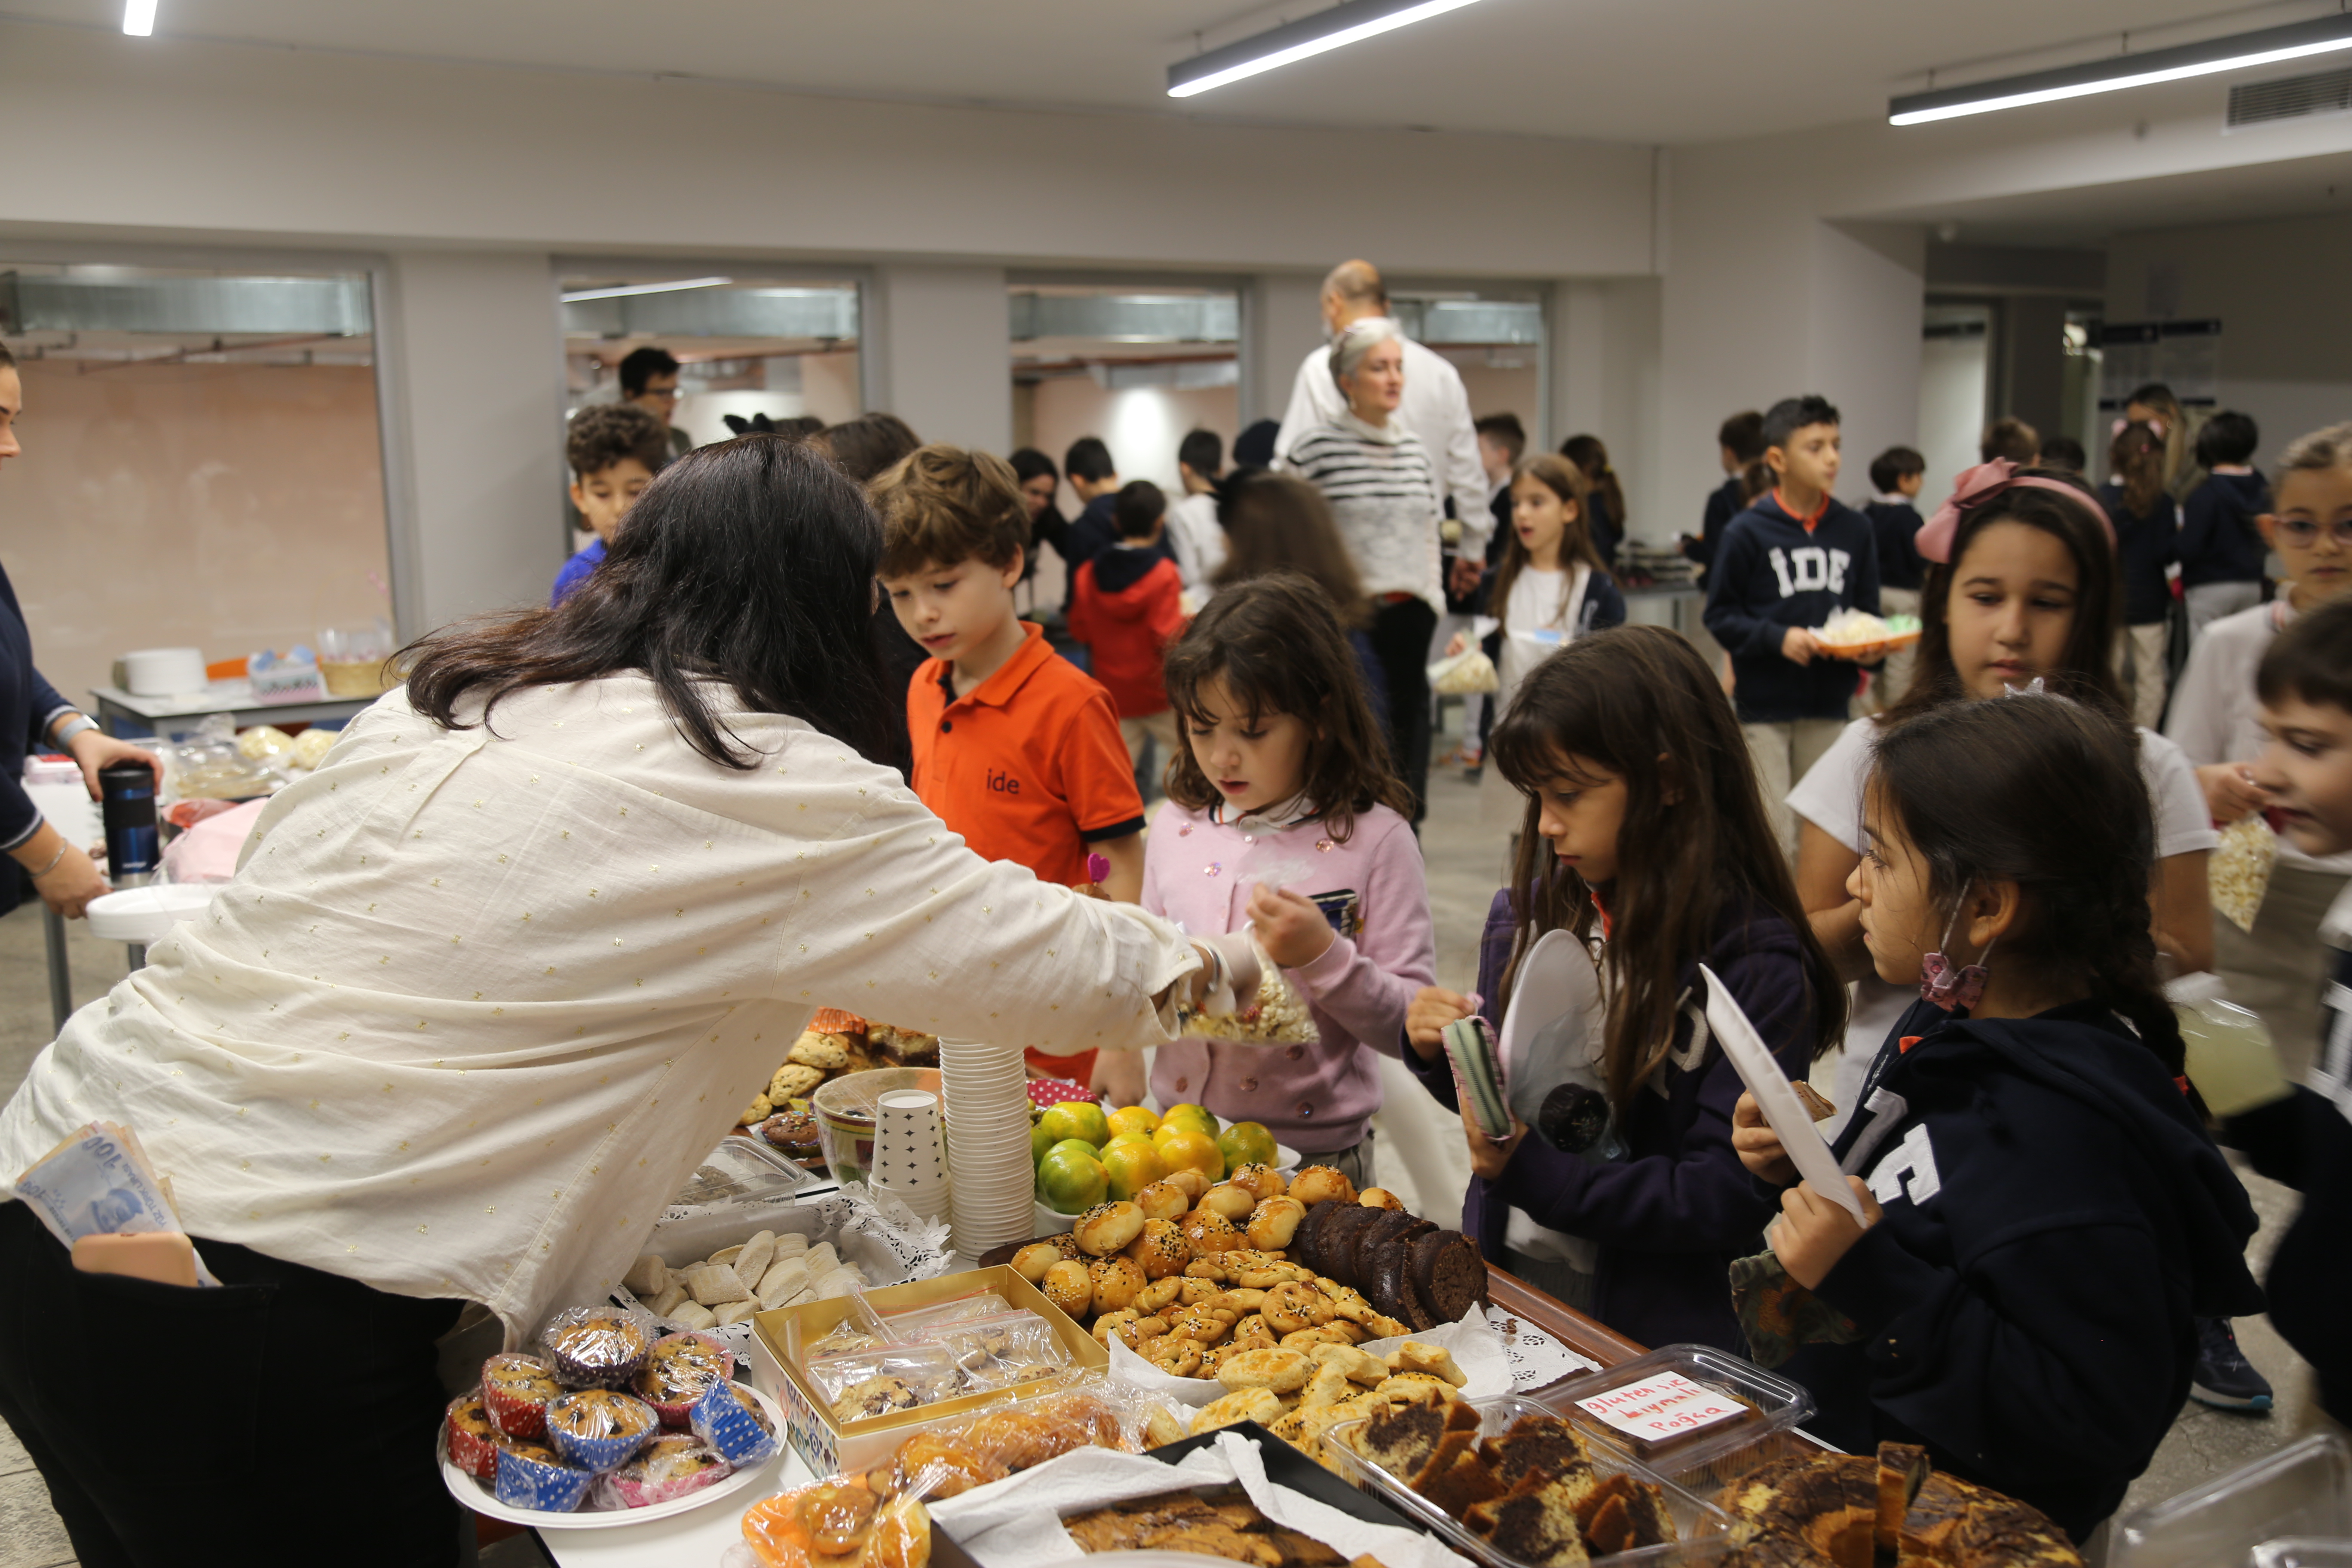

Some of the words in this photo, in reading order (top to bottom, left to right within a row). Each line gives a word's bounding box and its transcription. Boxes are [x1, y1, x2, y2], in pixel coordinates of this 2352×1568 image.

[1768, 546, 1850, 598] IDE
[987, 769, 1019, 794] ide
[82, 1137, 122, 1169] 100
[1586, 1388, 1656, 1414] gluten
